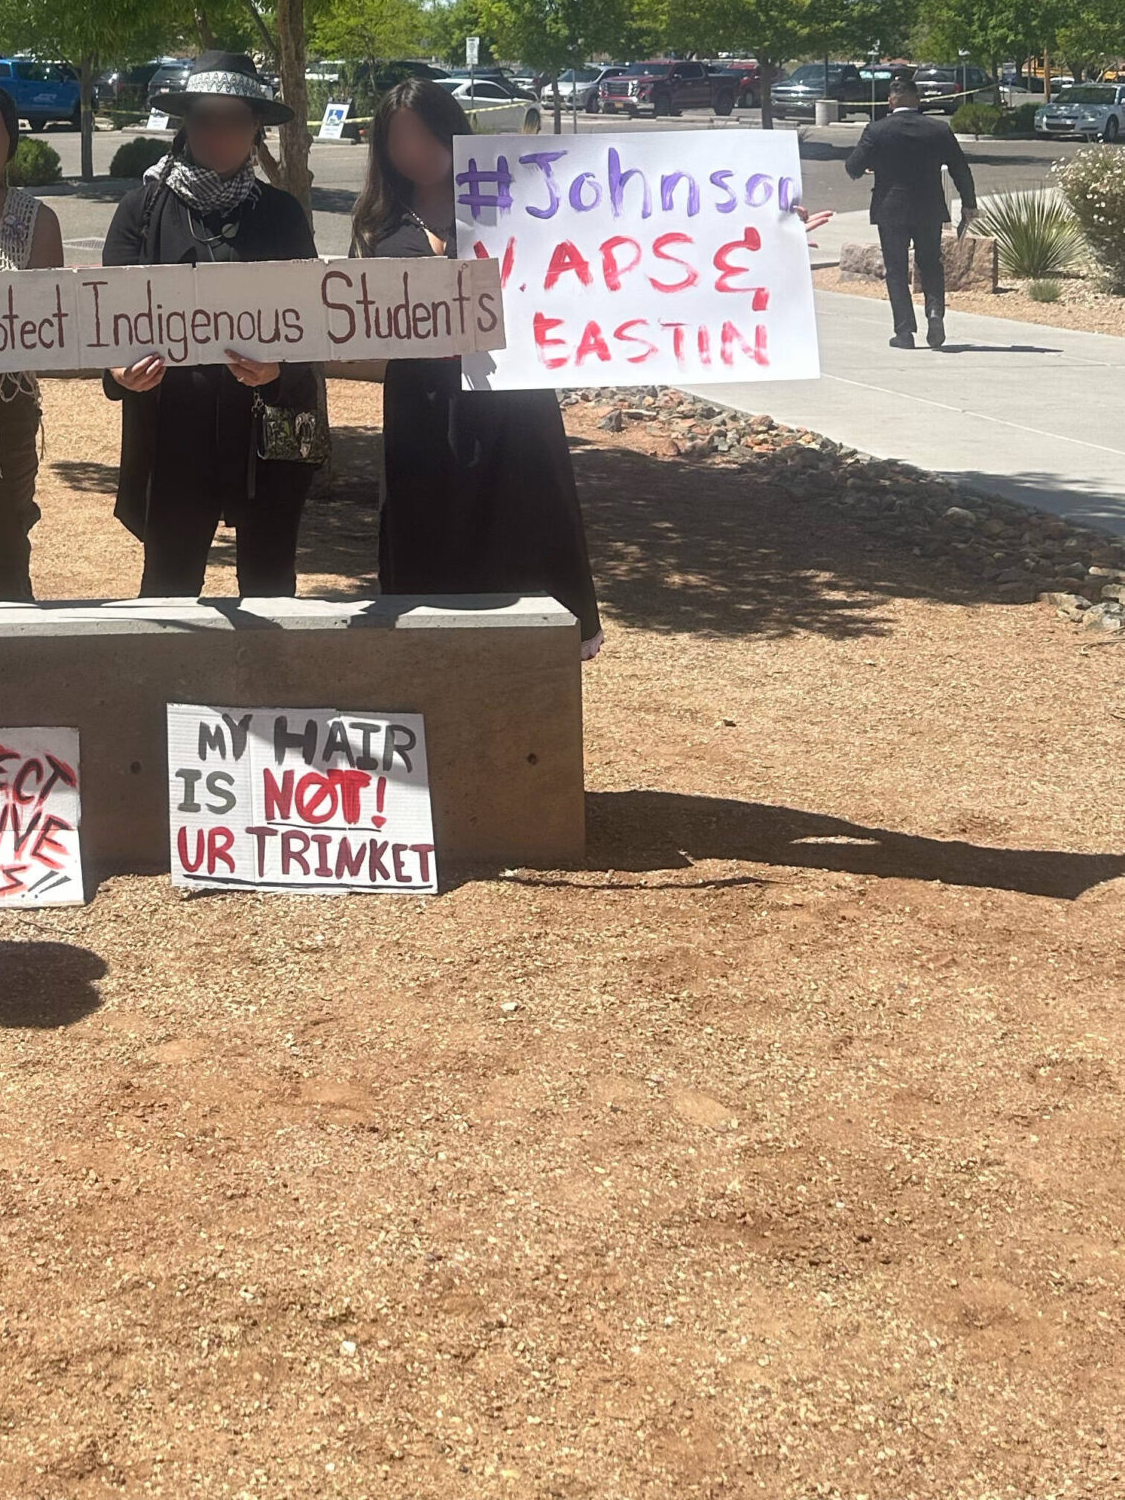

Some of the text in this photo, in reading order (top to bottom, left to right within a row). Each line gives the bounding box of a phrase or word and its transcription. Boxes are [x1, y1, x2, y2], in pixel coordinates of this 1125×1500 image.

[455, 147, 798, 219] #Johnson
[544, 232, 699, 292] APS
[82, 279, 304, 363] Indigenous
[321, 269, 497, 344] Students
[532, 311, 770, 371] EASTIN
[198, 713, 416, 773] MY HAIR
[175, 767, 387, 828] IS NOT!
[177, 826, 435, 882] UR TRINKET
